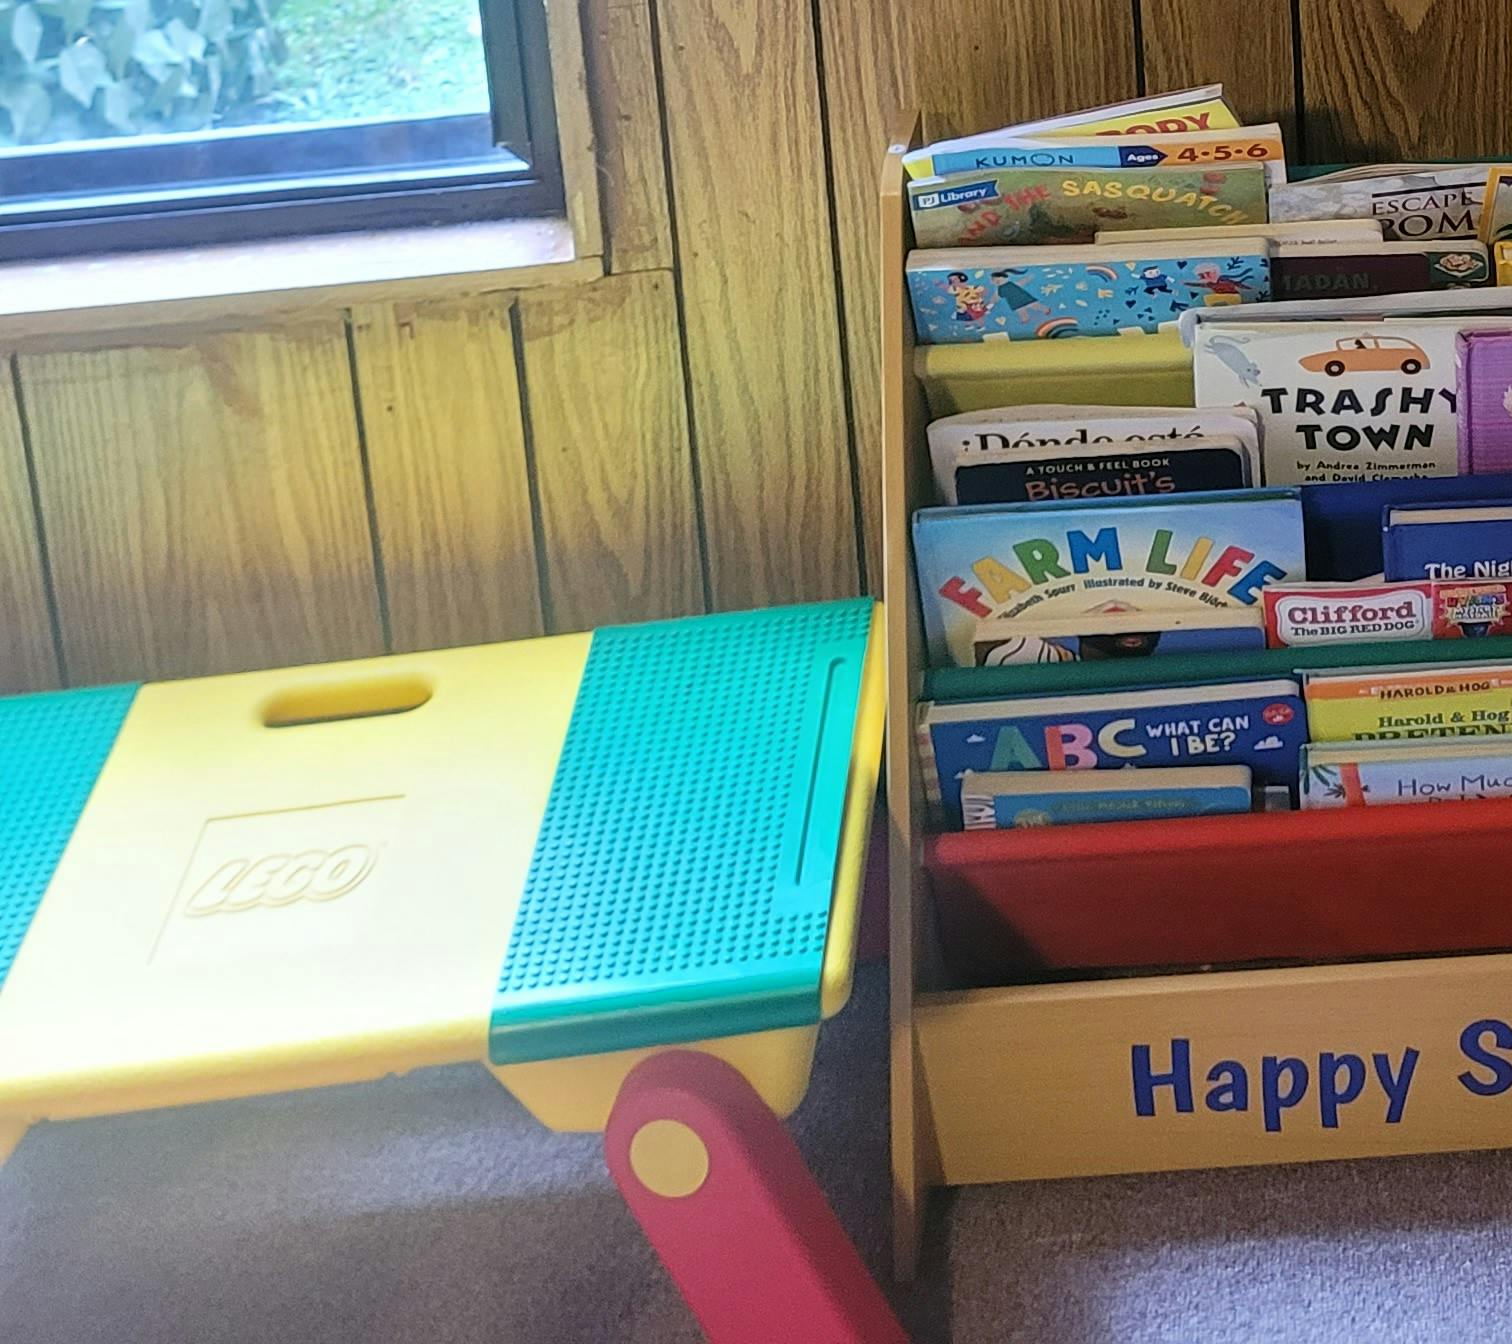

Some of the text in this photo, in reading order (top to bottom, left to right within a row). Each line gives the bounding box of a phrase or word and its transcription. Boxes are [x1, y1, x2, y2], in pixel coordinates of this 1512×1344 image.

[975, 152, 1075, 169] KUMON
[1126, 151, 1160, 163] Ages
[940, 187, 988, 204] Library
[1061, 179, 1249, 226] SASQUATCH
[1372, 189, 1473, 216] ESCAPE
[1261, 386, 1457, 417] TRASHY
[1295, 424, 1435, 451] TOWN
[1026, 466, 1034, 476] A
[1038, 463, 1083, 475] TOUCH
[1099, 460, 1129, 471] FEEL
[1132, 458, 1170, 469] BOOK
[1296, 460, 1436, 471] by Andrea Zimmerman
[1025, 470, 1176, 501] Biscuit's
[1304, 473, 1326, 482] and
[938, 526, 1289, 619] FARM LIFE
[1424, 562, 1467, 581] The
[1083, 577, 1145, 591] Illustrated
[1148, 578, 1163, 591] by
[1165, 581, 1198, 599] Steve
[1287, 601, 1417, 626] Clifford
[1290, 620, 1416, 638] The BIG RED DOG
[1379, 684, 1446, 700] HAROLD
[1458, 680, 1491, 693] HOG
[1378, 710, 1511, 728] Harold & Hog
[990, 715, 1250, 771] ABC WHAT CAN
[1169, 732, 1236, 757] I BE?
[1397, 777, 1451, 797] How
[185, 844, 378, 918] LEGO
[1130, 1038, 1421, 1133] Happy
